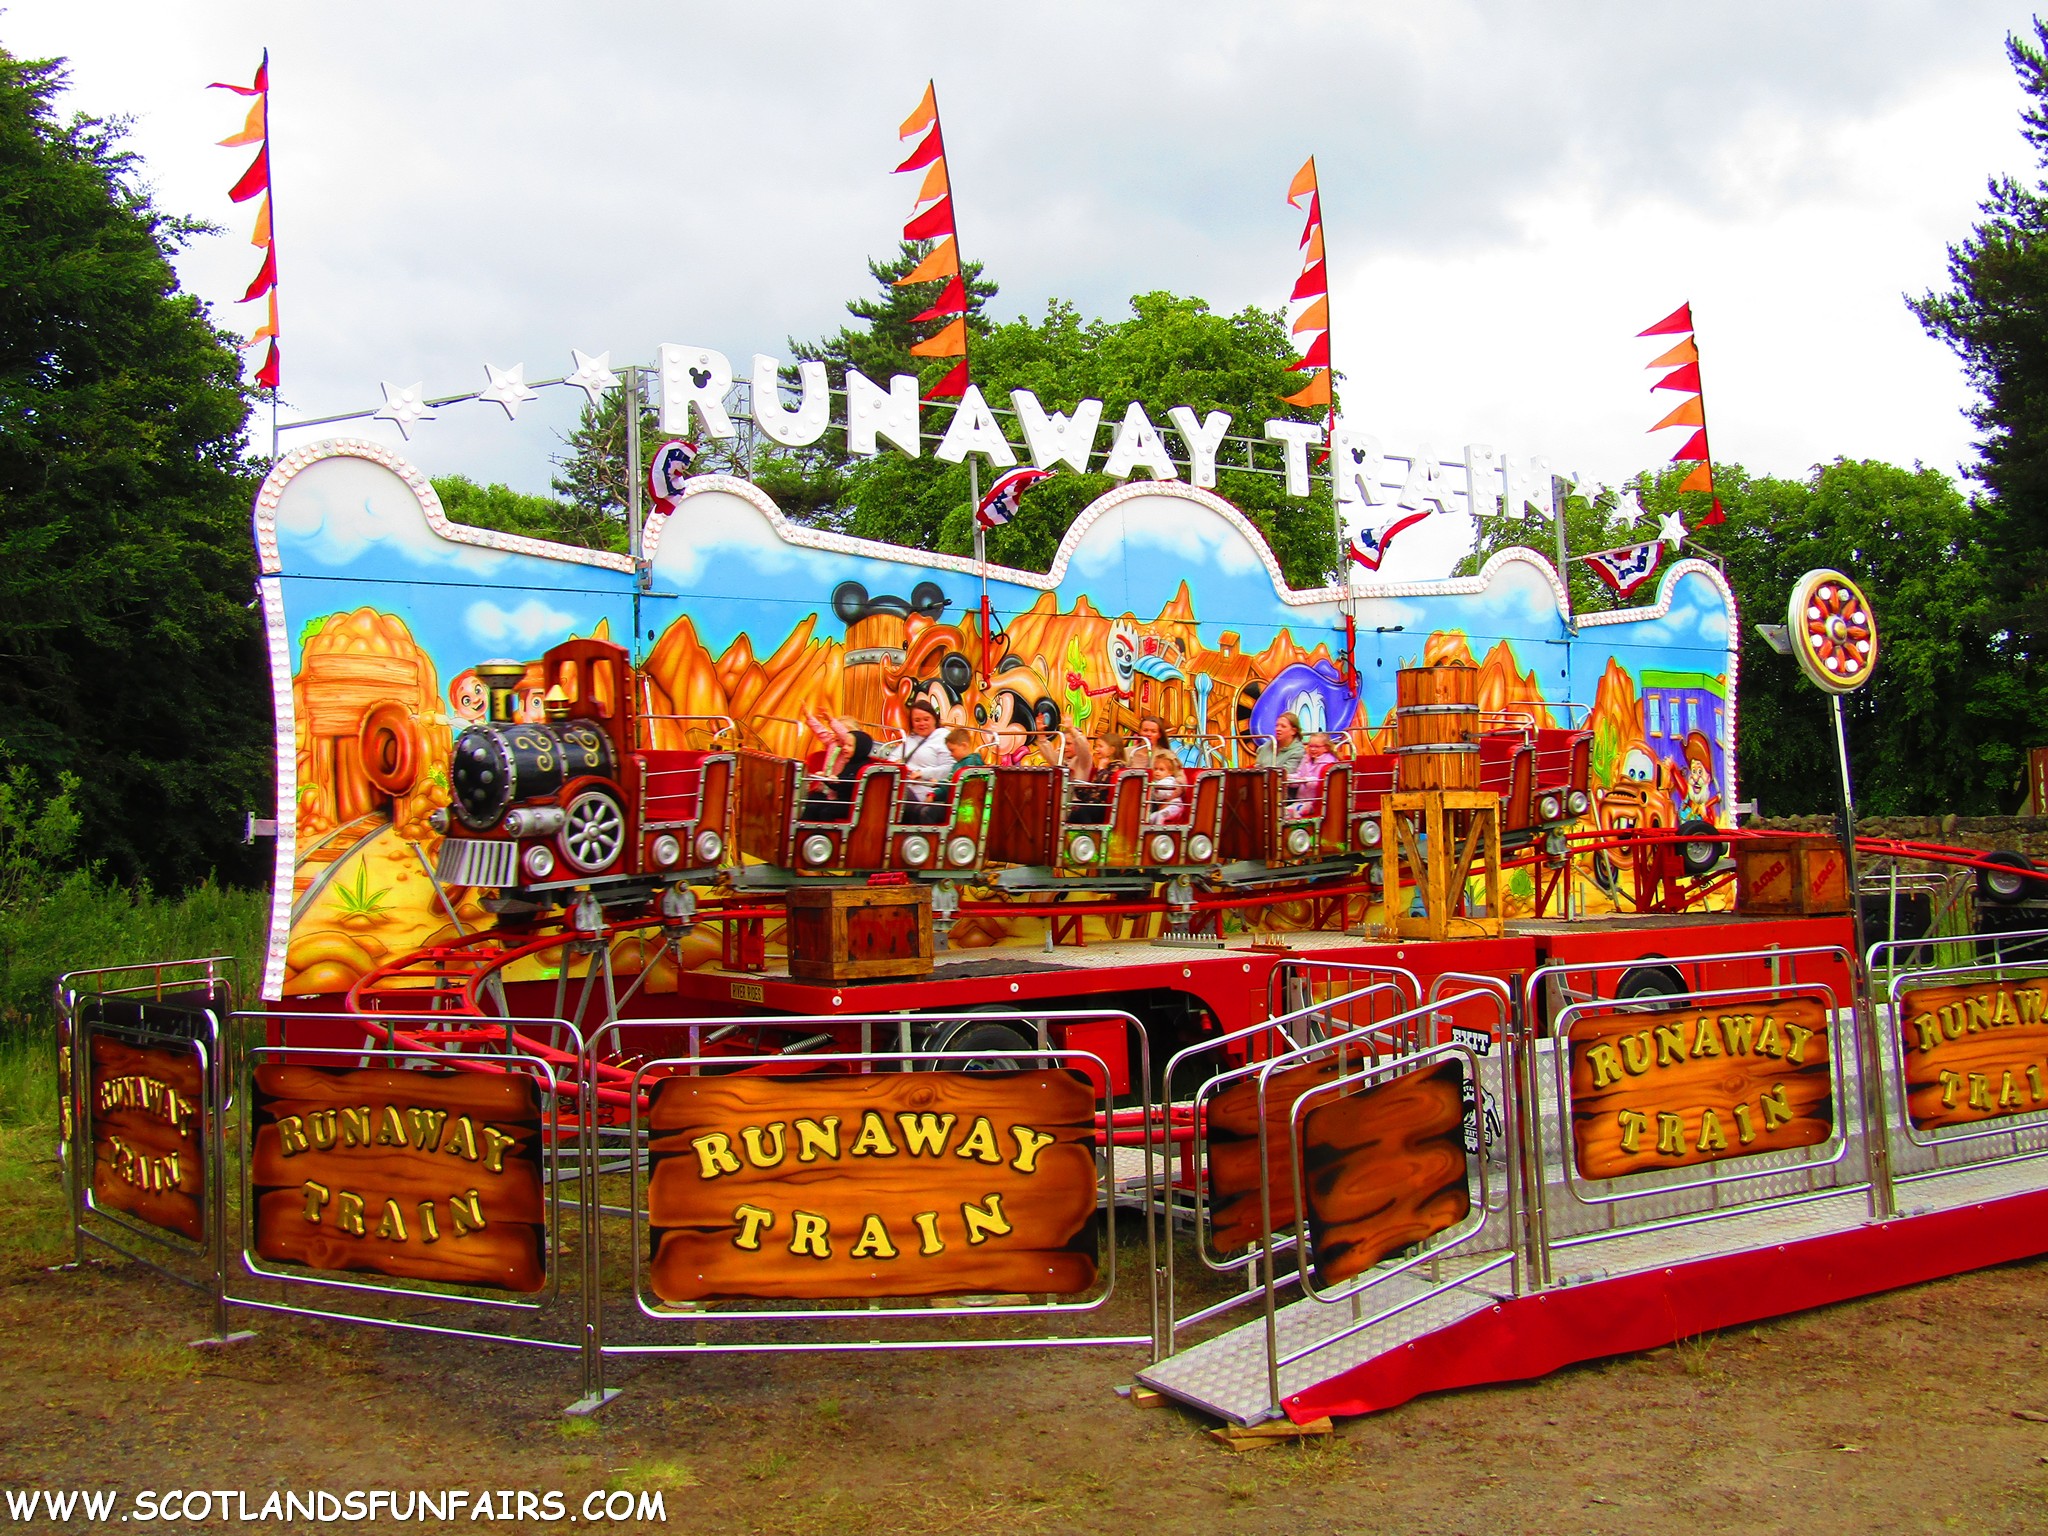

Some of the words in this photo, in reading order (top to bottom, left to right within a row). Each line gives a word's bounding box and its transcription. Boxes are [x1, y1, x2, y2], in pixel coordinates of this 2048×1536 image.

[656, 342, 1232, 489] RUNAWAY
[1264, 419, 1556, 522] TRAIN
[732, 984, 746, 999] RIVER
[747, 985, 762, 1001] RIDES
[1452, 1028, 1489, 1053] EXIT
[1586, 1013, 1815, 1088] RUNAWAY
[101, 1076, 195, 1138] RUNAWAY
[277, 1104, 515, 1174] RUNAWAY
[1617, 1082, 1794, 1155] TRAIN
[109, 1134, 183, 1193] TRAIN
[690, 1111, 1056, 1180] RUNAWAY
[301, 1179, 487, 1243] TRAIN
[733, 1192, 1013, 1260] TRAIN
